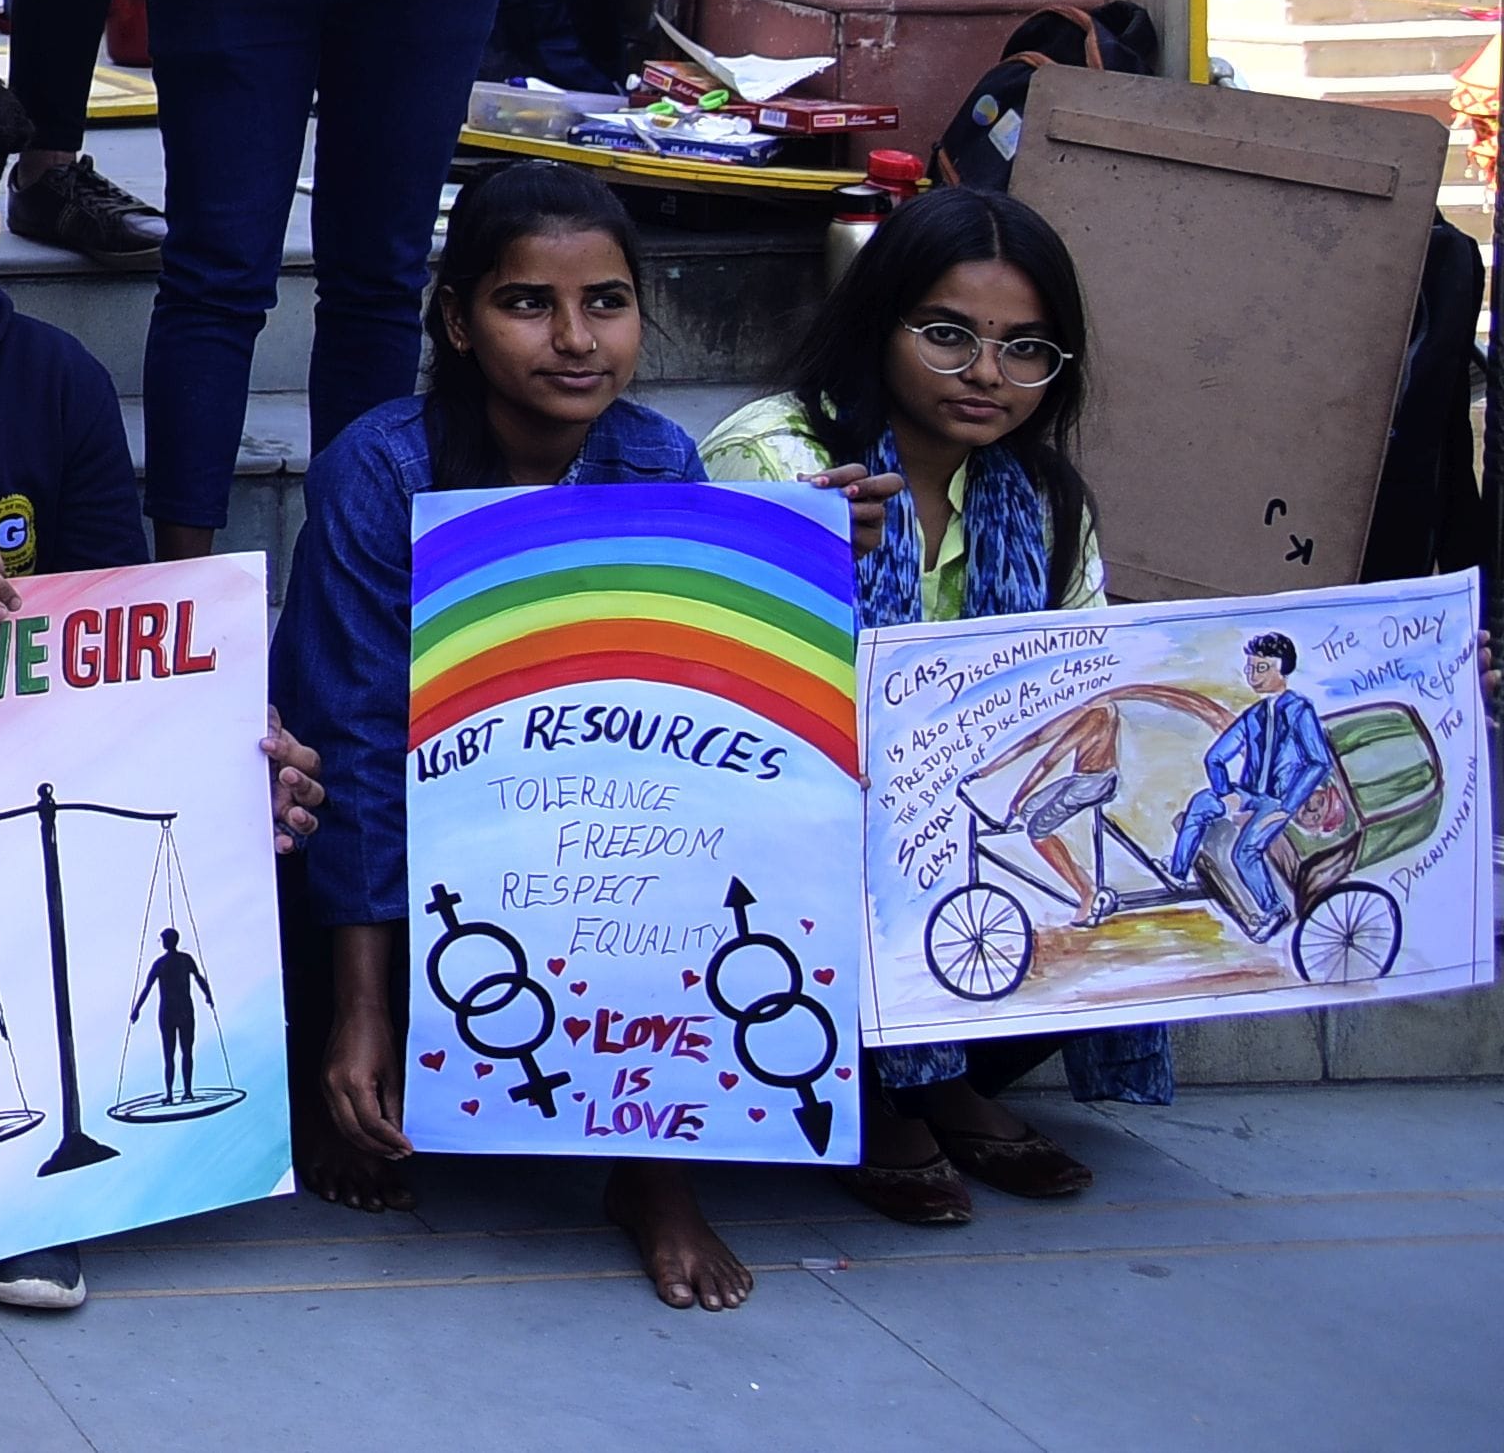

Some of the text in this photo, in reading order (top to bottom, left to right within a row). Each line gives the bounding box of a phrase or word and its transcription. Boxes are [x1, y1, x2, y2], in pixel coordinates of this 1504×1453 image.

[62, 599, 217, 690] GIRL
[1381, 609, 1446, 648] ONLY
[884, 626, 1110, 706] CLASS DISCRIMINATION
[1350, 657, 1412, 696] NAME
[911, 721, 950, 753] ALSO
[957, 692, 1012, 731] KNOW
[1018, 680, 1042, 701] AS
[1049, 652, 1122, 687] CLASSIC
[416, 703, 788, 783] LGBT RESOURCES
[892, 743, 974, 794] PREJUDICE
[980, 673, 1114, 743] DISCRIMINATION
[486, 776, 682, 813] TOLERANCE
[556, 820, 726, 866] FREEDOM
[896, 803, 959, 875] SOCIAL
[918, 842, 959, 891] CLASS
[500, 872, 661, 910] RESPECT
[569, 917, 729, 956] EQUALITY
[592, 1008, 716, 1063] LOVE
[611, 1067, 654, 1099] IS
[583, 1101, 709, 1141] LOVE
